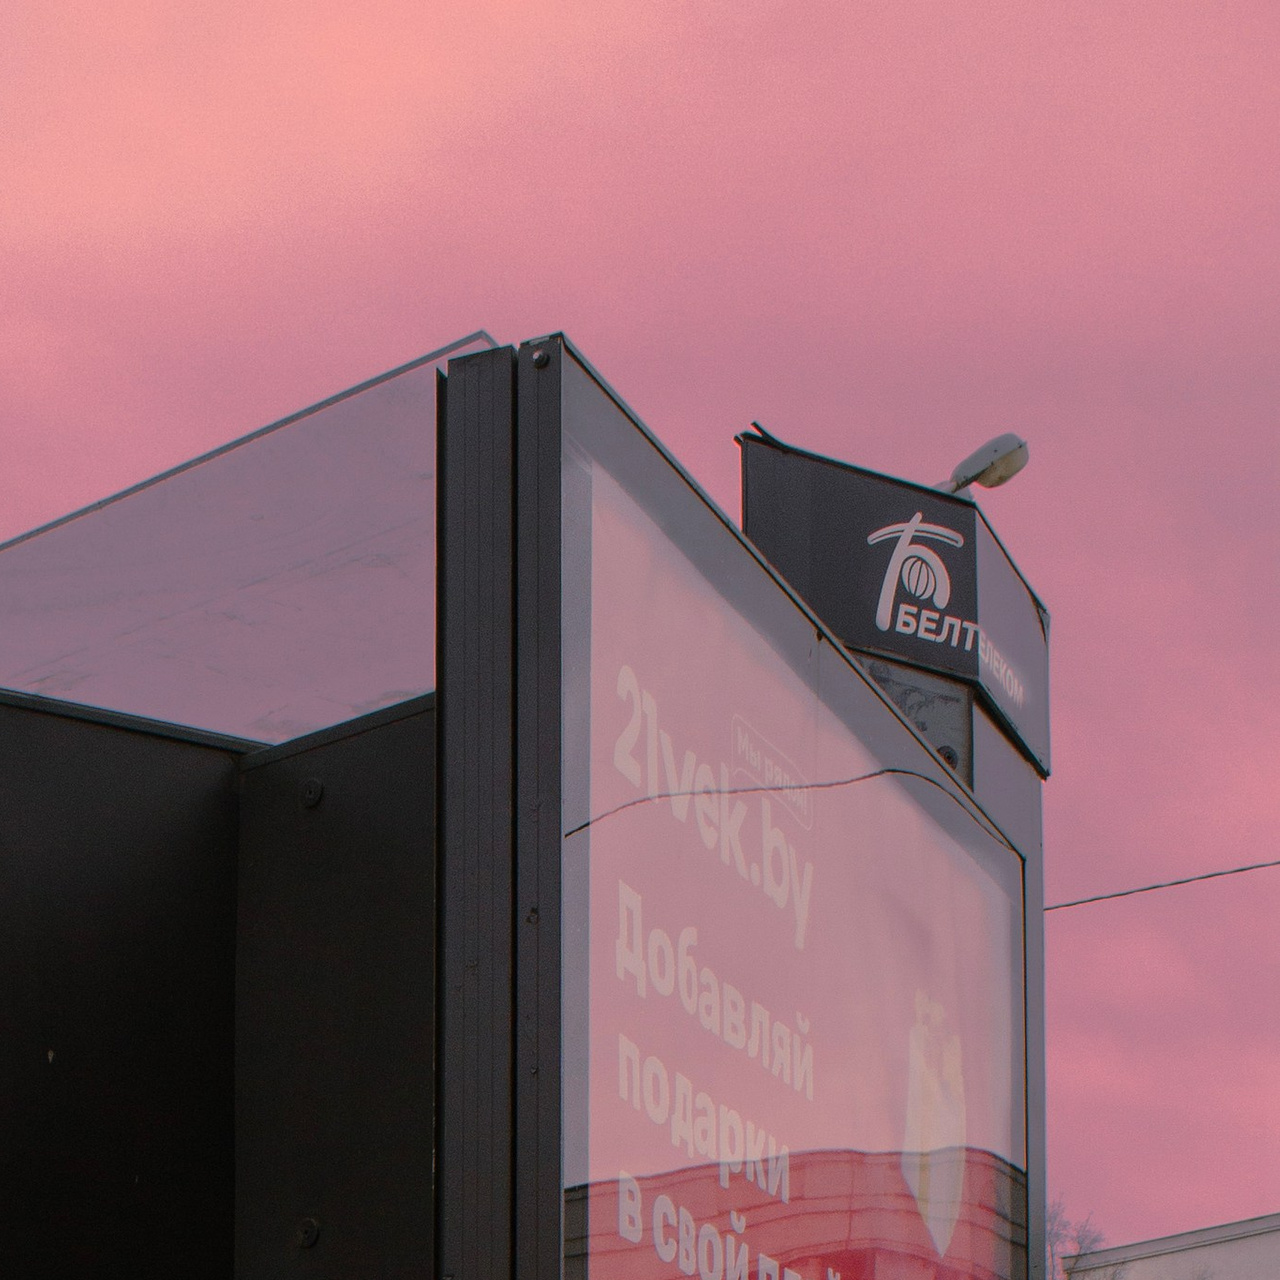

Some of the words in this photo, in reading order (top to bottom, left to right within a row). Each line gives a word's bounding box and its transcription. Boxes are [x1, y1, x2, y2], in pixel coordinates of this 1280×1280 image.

[612, 664, 815, 951] 21vek.by
[615, 878, 814, 1100] Добавляй
[619, 1033, 790, 1204] подарки
